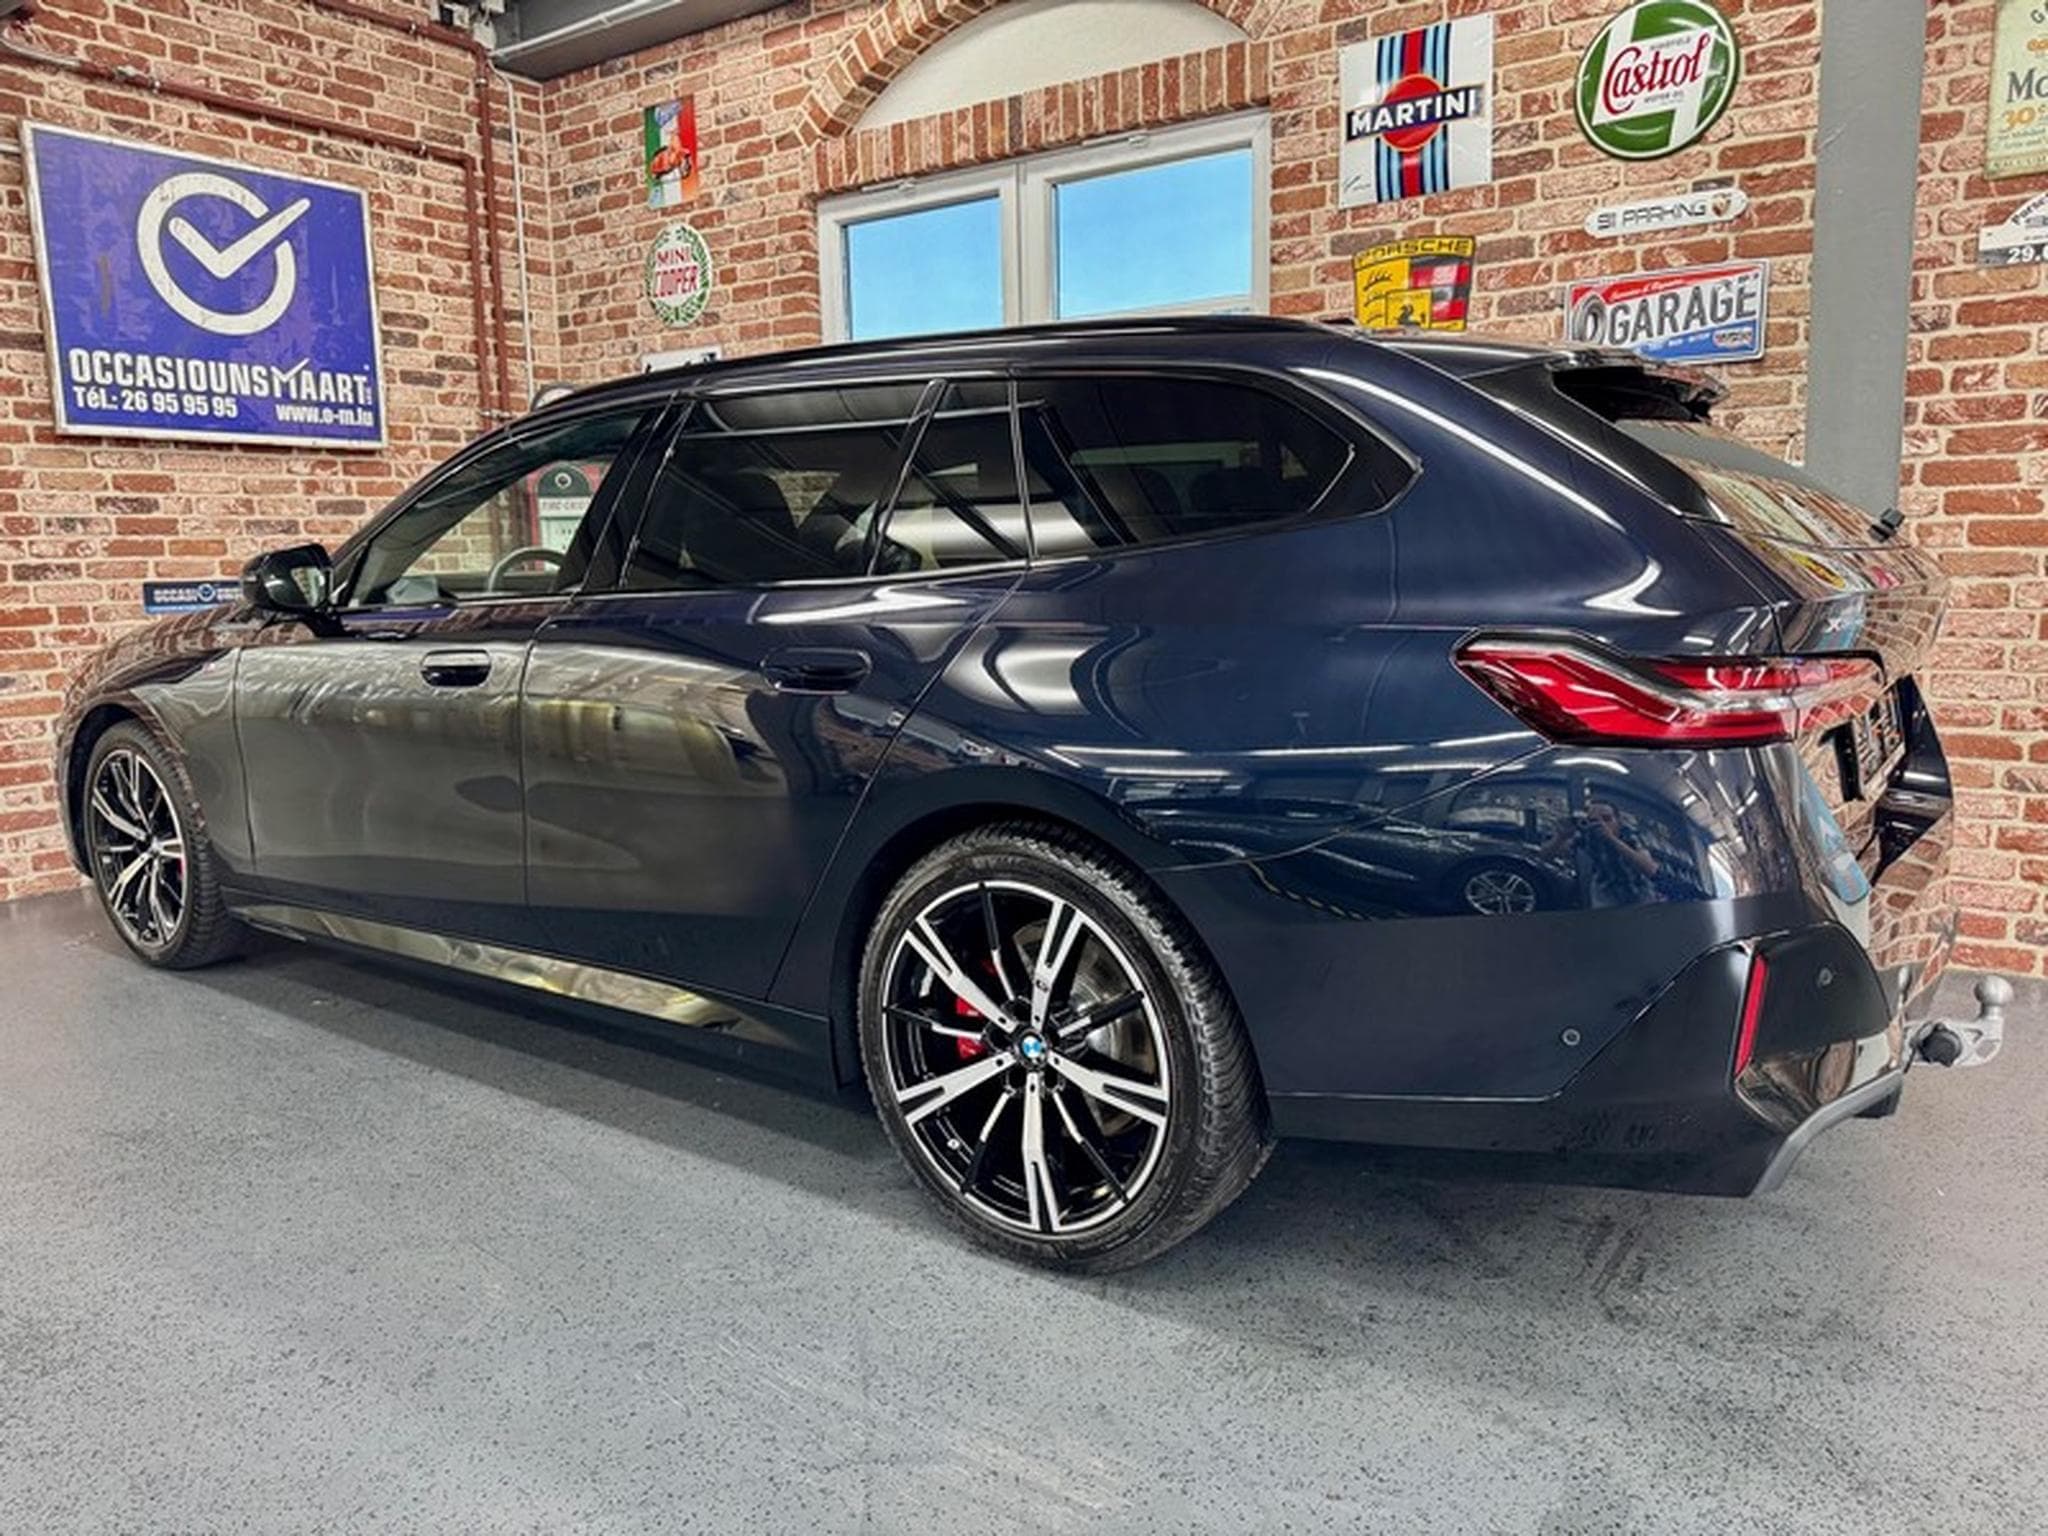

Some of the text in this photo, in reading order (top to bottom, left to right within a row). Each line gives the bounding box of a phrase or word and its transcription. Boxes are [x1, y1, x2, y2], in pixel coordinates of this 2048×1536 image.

[1603, 32, 1711, 116] Castrol
[1351, 89, 1476, 137] MARTINI
[1623, 203, 1706, 227] PARKING
[657, 246, 691, 266] MINI
[1357, 239, 1470, 267] PORSCHE
[653, 265, 698, 298] COOPER
[1608, 275, 1757, 346] GARAGE
[69, 348, 367, 405] OCCASIOUNSMAART
[121, 390, 149, 413] 26
[152, 391, 179, 414] 95
[183, 393, 209, 416] 95
[213, 396, 239, 418] 95
[276, 403, 374, 427] www.o-m.lu
